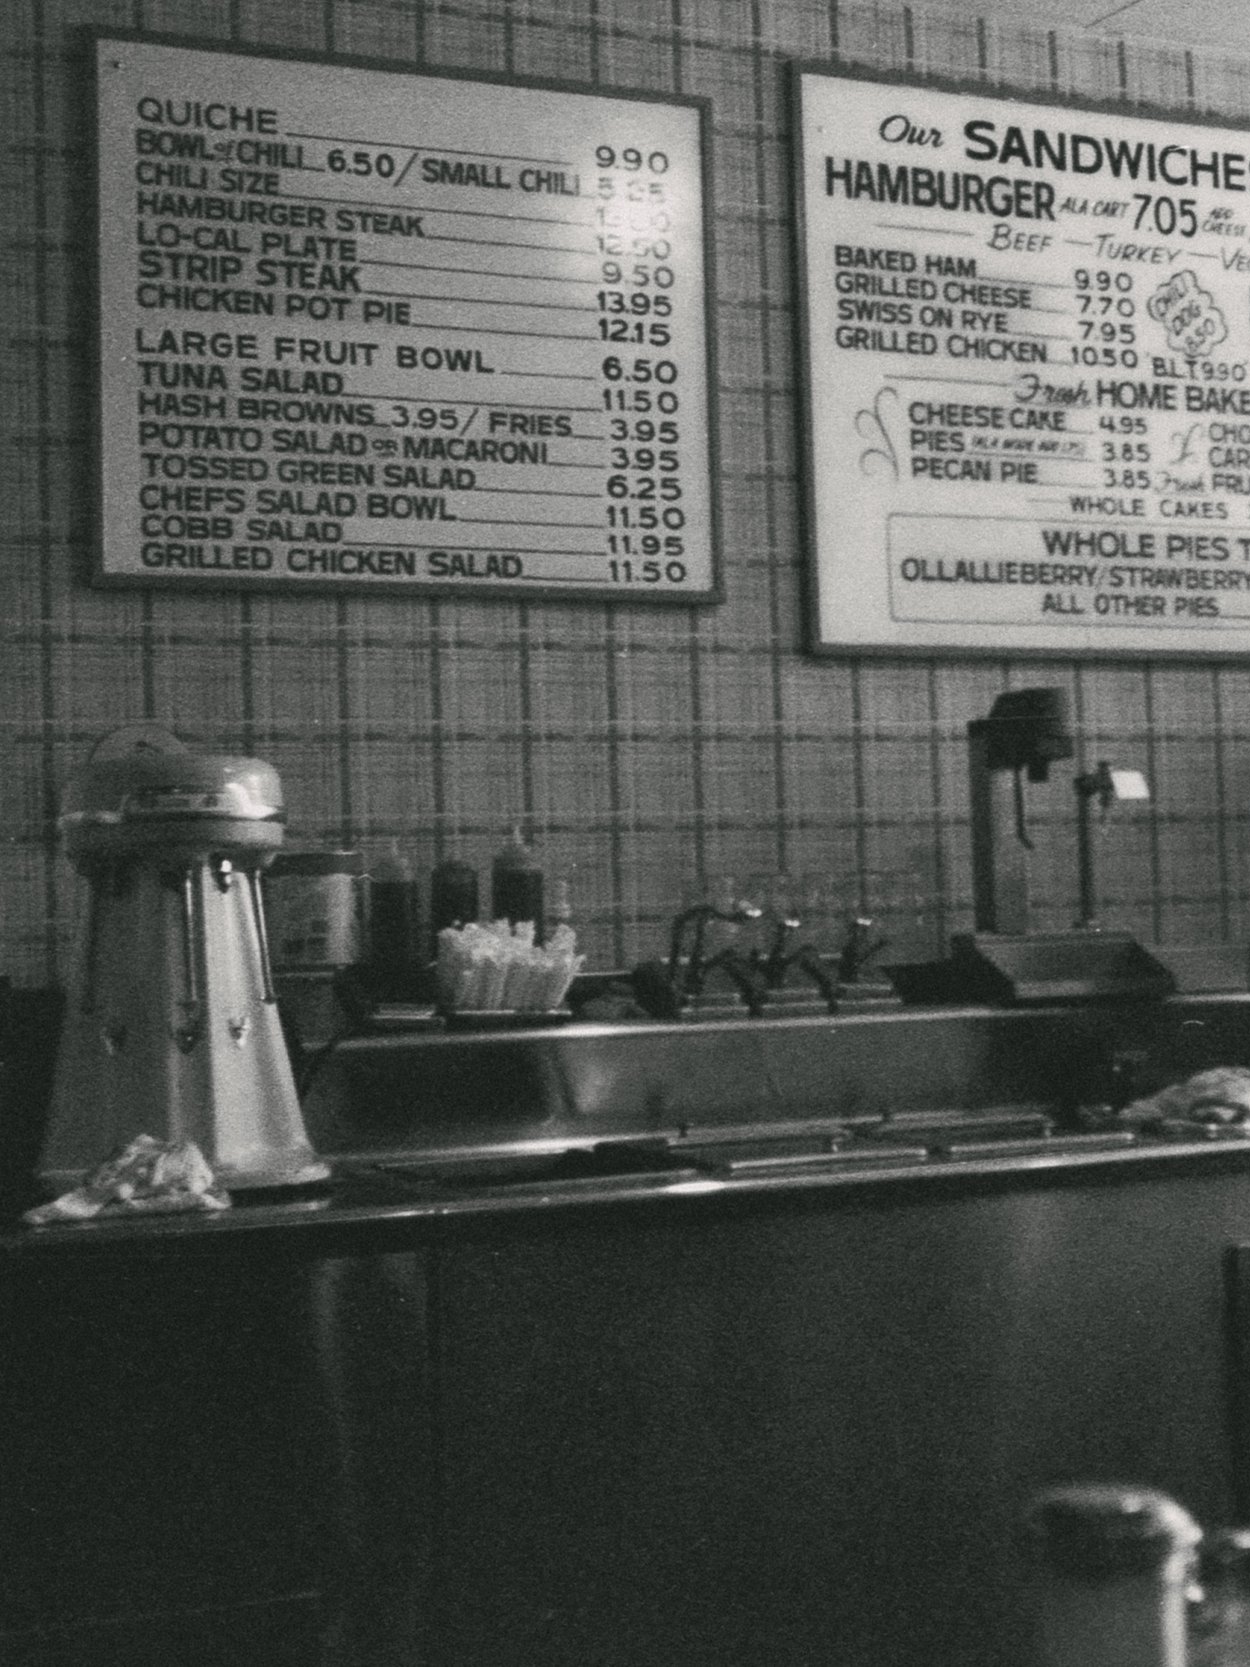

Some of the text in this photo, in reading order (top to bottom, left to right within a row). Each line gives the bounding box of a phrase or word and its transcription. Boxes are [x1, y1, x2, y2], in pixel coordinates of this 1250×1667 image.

[136, 97, 668, 173] QUICHE 9.90
[136, 128, 214, 160] BOWL
[236, 139, 303, 168] CHILI
[879, 114, 944, 148] Our
[135, 160, 279, 196] CHILI SIZE
[825, 155, 1056, 222] HAMBURGER
[1133, 193, 1197, 238] 7.05
[137, 192, 326, 229] HAMBURGER
[336, 209, 425, 237] STEAK
[137, 220, 674, 289] LO-CAL PLATE 9.50
[834, 244, 917, 273] BAKED
[925, 254, 976, 278] HAM
[138, 250, 672, 317] STRIP STEAK 13.95
[835, 271, 1135, 318] GRILLED CHEESE 7.70
[137, 283, 671, 346] CHICKEN POT PIE 12.15
[838, 298, 912, 324] SWISS
[919, 305, 953, 328] ON
[961, 309, 1008, 334] RYE
[135, 328, 678, 384] LARGE FRUIT BOWL 6.50
[835, 325, 1047, 363] GRILLED CHICKEN
[138, 360, 678, 414] TUNA SALAD 11.50
[1152, 356, 1198, 381] BLT
[1097, 380, 1177, 410] HOME
[138, 390, 226, 419] HASH
[238, 398, 374, 426] BROWNS
[489, 412, 572, 437] FRIES
[610, 419, 679, 444] 3.95
[908, 401, 1004, 429] CHEESE
[1009, 407, 1066, 431] CAKE
[139, 421, 262, 451] POTATO
[273, 429, 367, 456] SALAD
[403, 436, 547, 464] MACARONI
[611, 447, 679, 472] 3.95
[910, 429, 964, 452] PIES
[141, 453, 682, 500] TOSSED GREEN SALAD 6.25
[911, 457, 991, 481] PECAN
[1001, 462, 1038, 484] PIE
[257, 489, 356, 516] SALAD
[367, 493, 456, 521] BOWL
[606, 505, 685, 530] 11.50
[1070, 495, 1228, 519] WHOLE CAKES
[141, 514, 684, 556] COBB SALAD 11.95
[1042, 530, 1154, 558] WHOLE
[1167, 534, 1229, 561] PIES
[141, 542, 686, 583] GRILLED CHICKEN SALAD 11.50
[1042, 593, 1083, 614] ALL
[1094, 594, 1166, 616] OTHER
[1175, 596, 1219, 617] PIES
